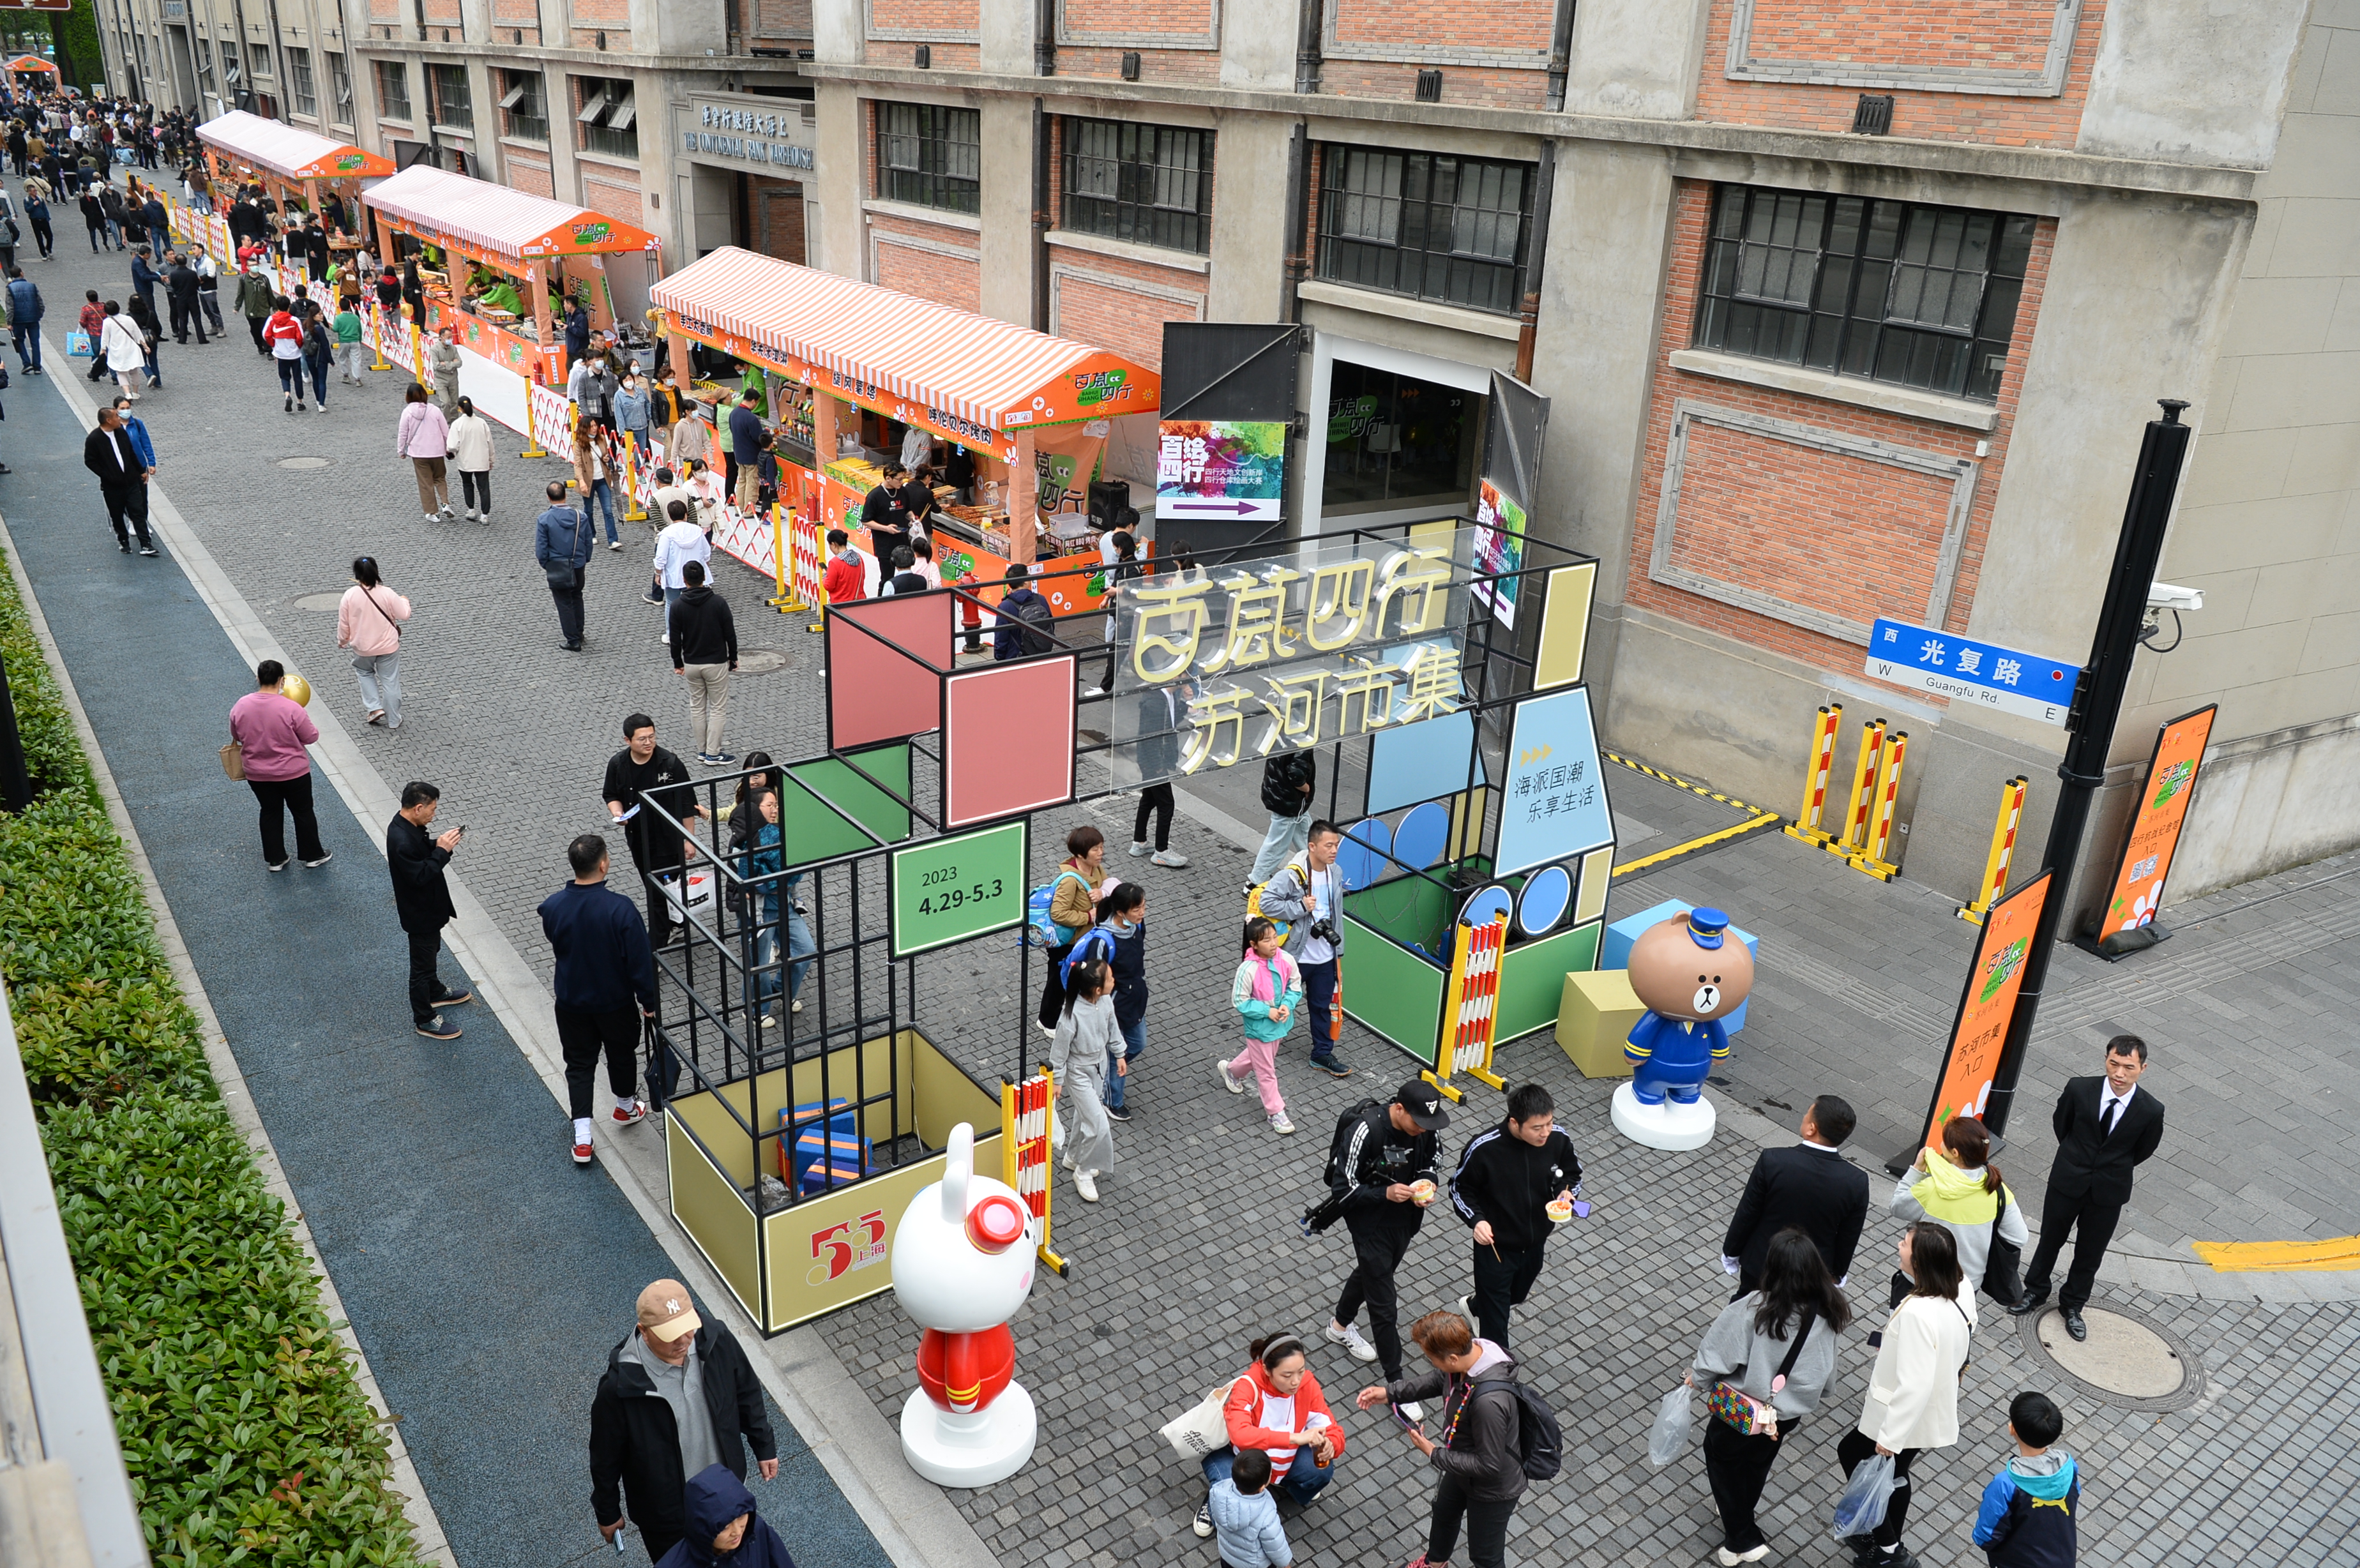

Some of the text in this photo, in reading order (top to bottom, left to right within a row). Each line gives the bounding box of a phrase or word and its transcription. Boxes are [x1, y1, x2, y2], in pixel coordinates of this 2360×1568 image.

[684, 132, 813, 170] THE CONTINENTAL BANK WAREHOUSE
[750, 340, 789, 366] 华夫冰淇淋
[833, 371, 876, 400] 旋风薯塔
[1100, 384, 1134, 402] 四行
[1077, 395, 1100, 403] SIHANG
[928, 407, 992, 445] 呼伦贝尔烤肉
[1350, 416, 1385, 437] 四行
[1161, 435, 1208, 464] 百绘
[1160, 459, 1206, 483] 四行
[1204, 476, 1263, 485] 四行仓库绘画大赛
[1205, 468, 1263, 477] 四行天地文创新岸
[1041, 481, 1085, 513] 四行
[1075, 538, 1085, 546] BBQ
[1085, 535, 1096, 544] 烤肉
[1884, 628, 1899, 643] 西
[1879, 663, 1892, 676] W
[1919, 640, 2022, 686] 光复路
[1926, 677, 2000, 704] Guangfu Rd.
[1181, 644, 1460, 775] 苏河市集
[2045, 707, 2057, 720] E
[1514, 760, 1584, 799] 海派国潮
[1527, 784, 1594, 824] 乐享生活
[2142, 842, 2158, 857] 入口
[921, 866, 957, 887] 2023
[919, 878, 1002, 916] 4.29-5.3
[1999, 953, 2027, 984] 四行
[1980, 983, 1999, 999] SIHANG
[1956, 1022, 2002, 1064] 苏河市集
[1960, 1055, 1984, 1082] 入口
[856, 1242, 886, 1263] 上海
[666, 1298, 681, 1315] NY
